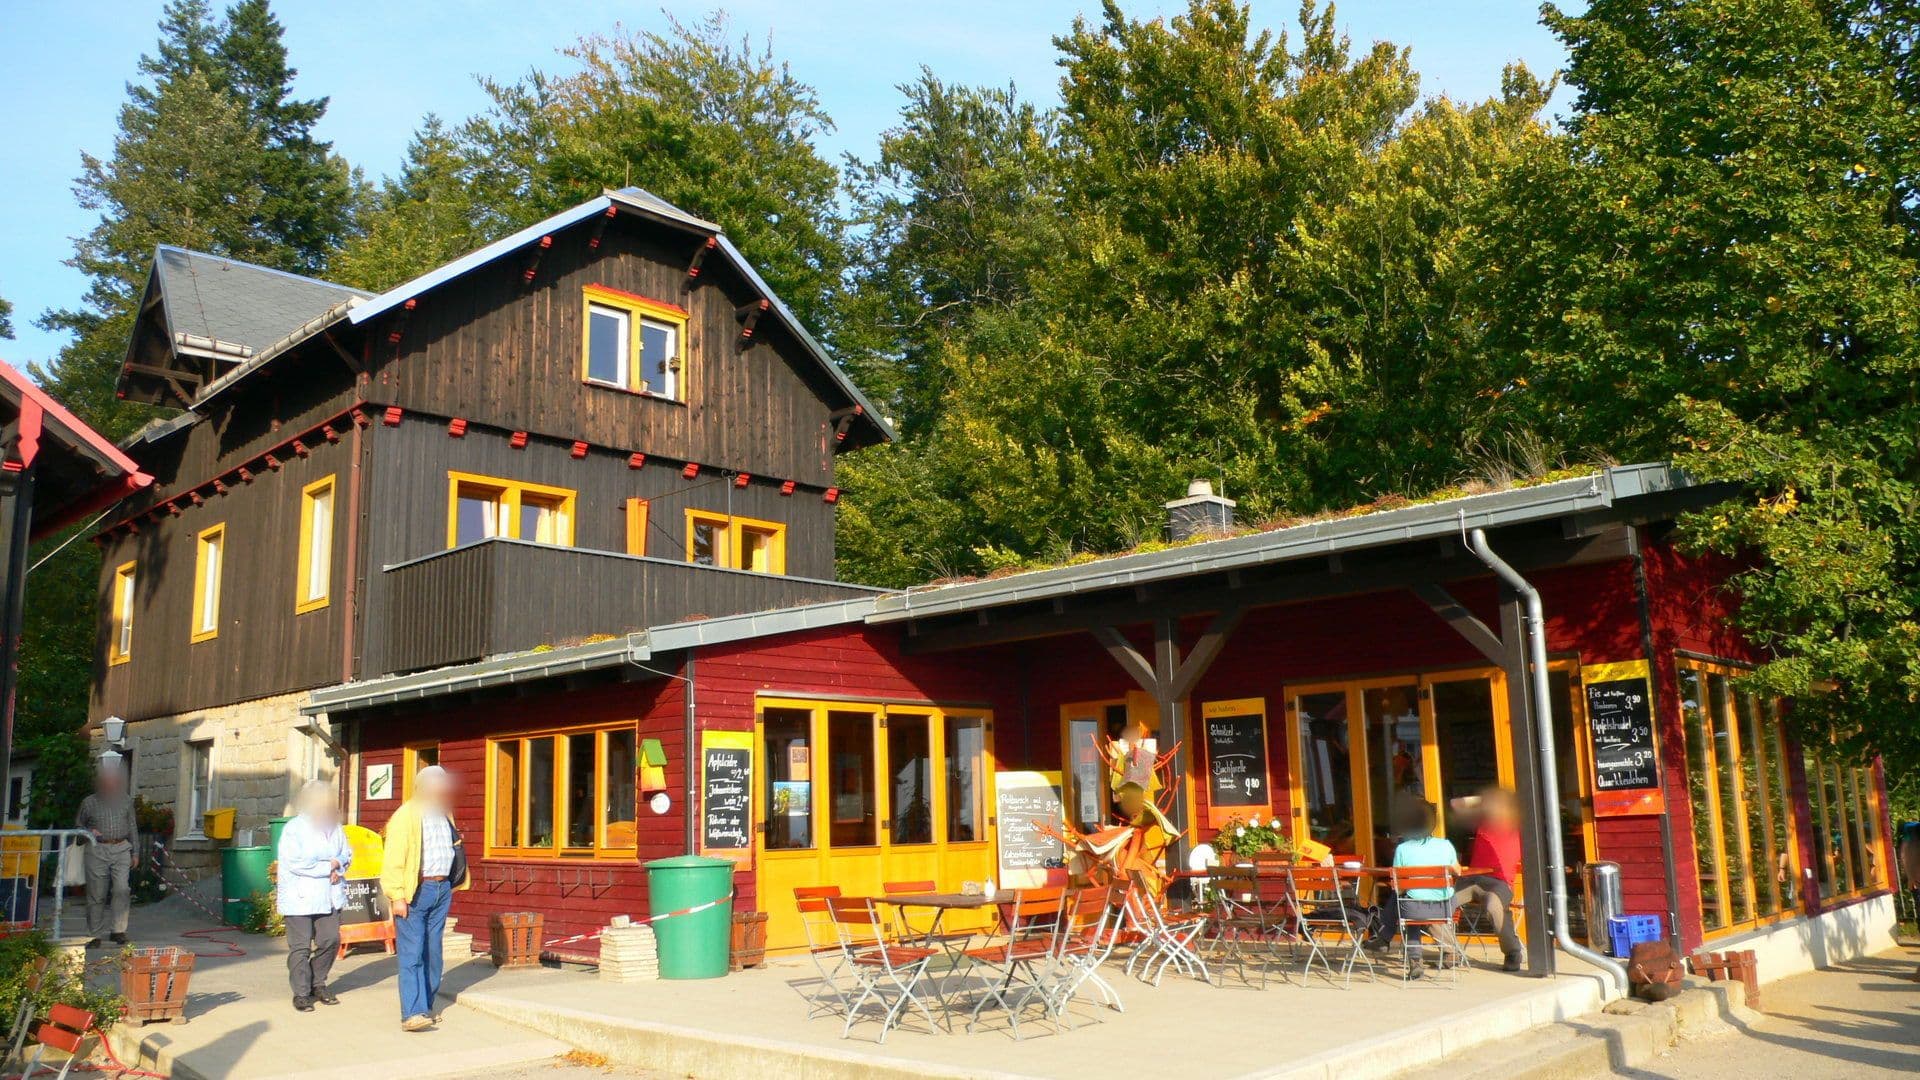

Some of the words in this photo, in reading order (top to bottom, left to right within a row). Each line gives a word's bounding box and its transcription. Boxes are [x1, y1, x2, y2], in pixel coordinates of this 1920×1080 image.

[1588, 687, 1601, 699] Eis
[1210, 724, 1234, 737] Schnitzel
[1592, 715, 1632, 735] Apfelstrudel
[1212, 760, 1246, 778] Bachforelle
